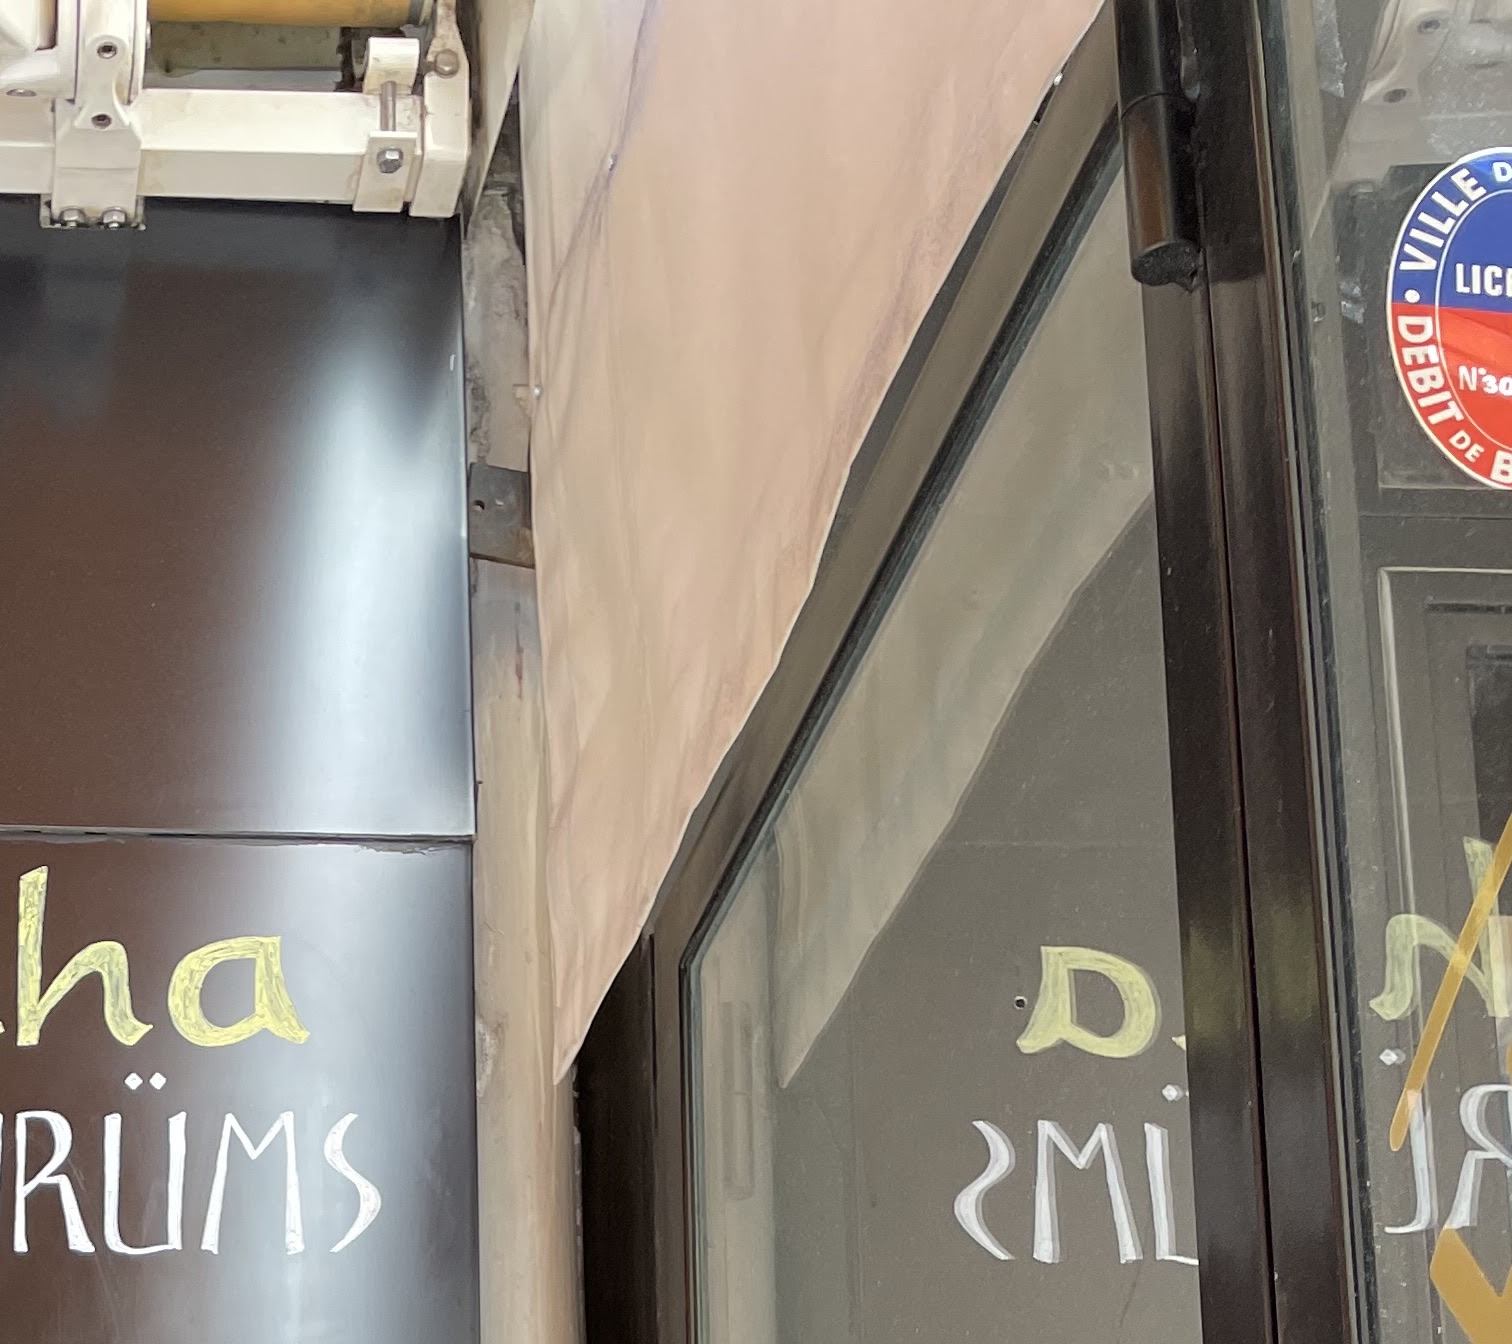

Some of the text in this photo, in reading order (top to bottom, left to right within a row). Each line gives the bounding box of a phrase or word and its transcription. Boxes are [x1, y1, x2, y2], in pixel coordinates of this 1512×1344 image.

[1399, 168, 1487, 271] VILLE
[1398, 316, 1485, 463] DEBIT DE
